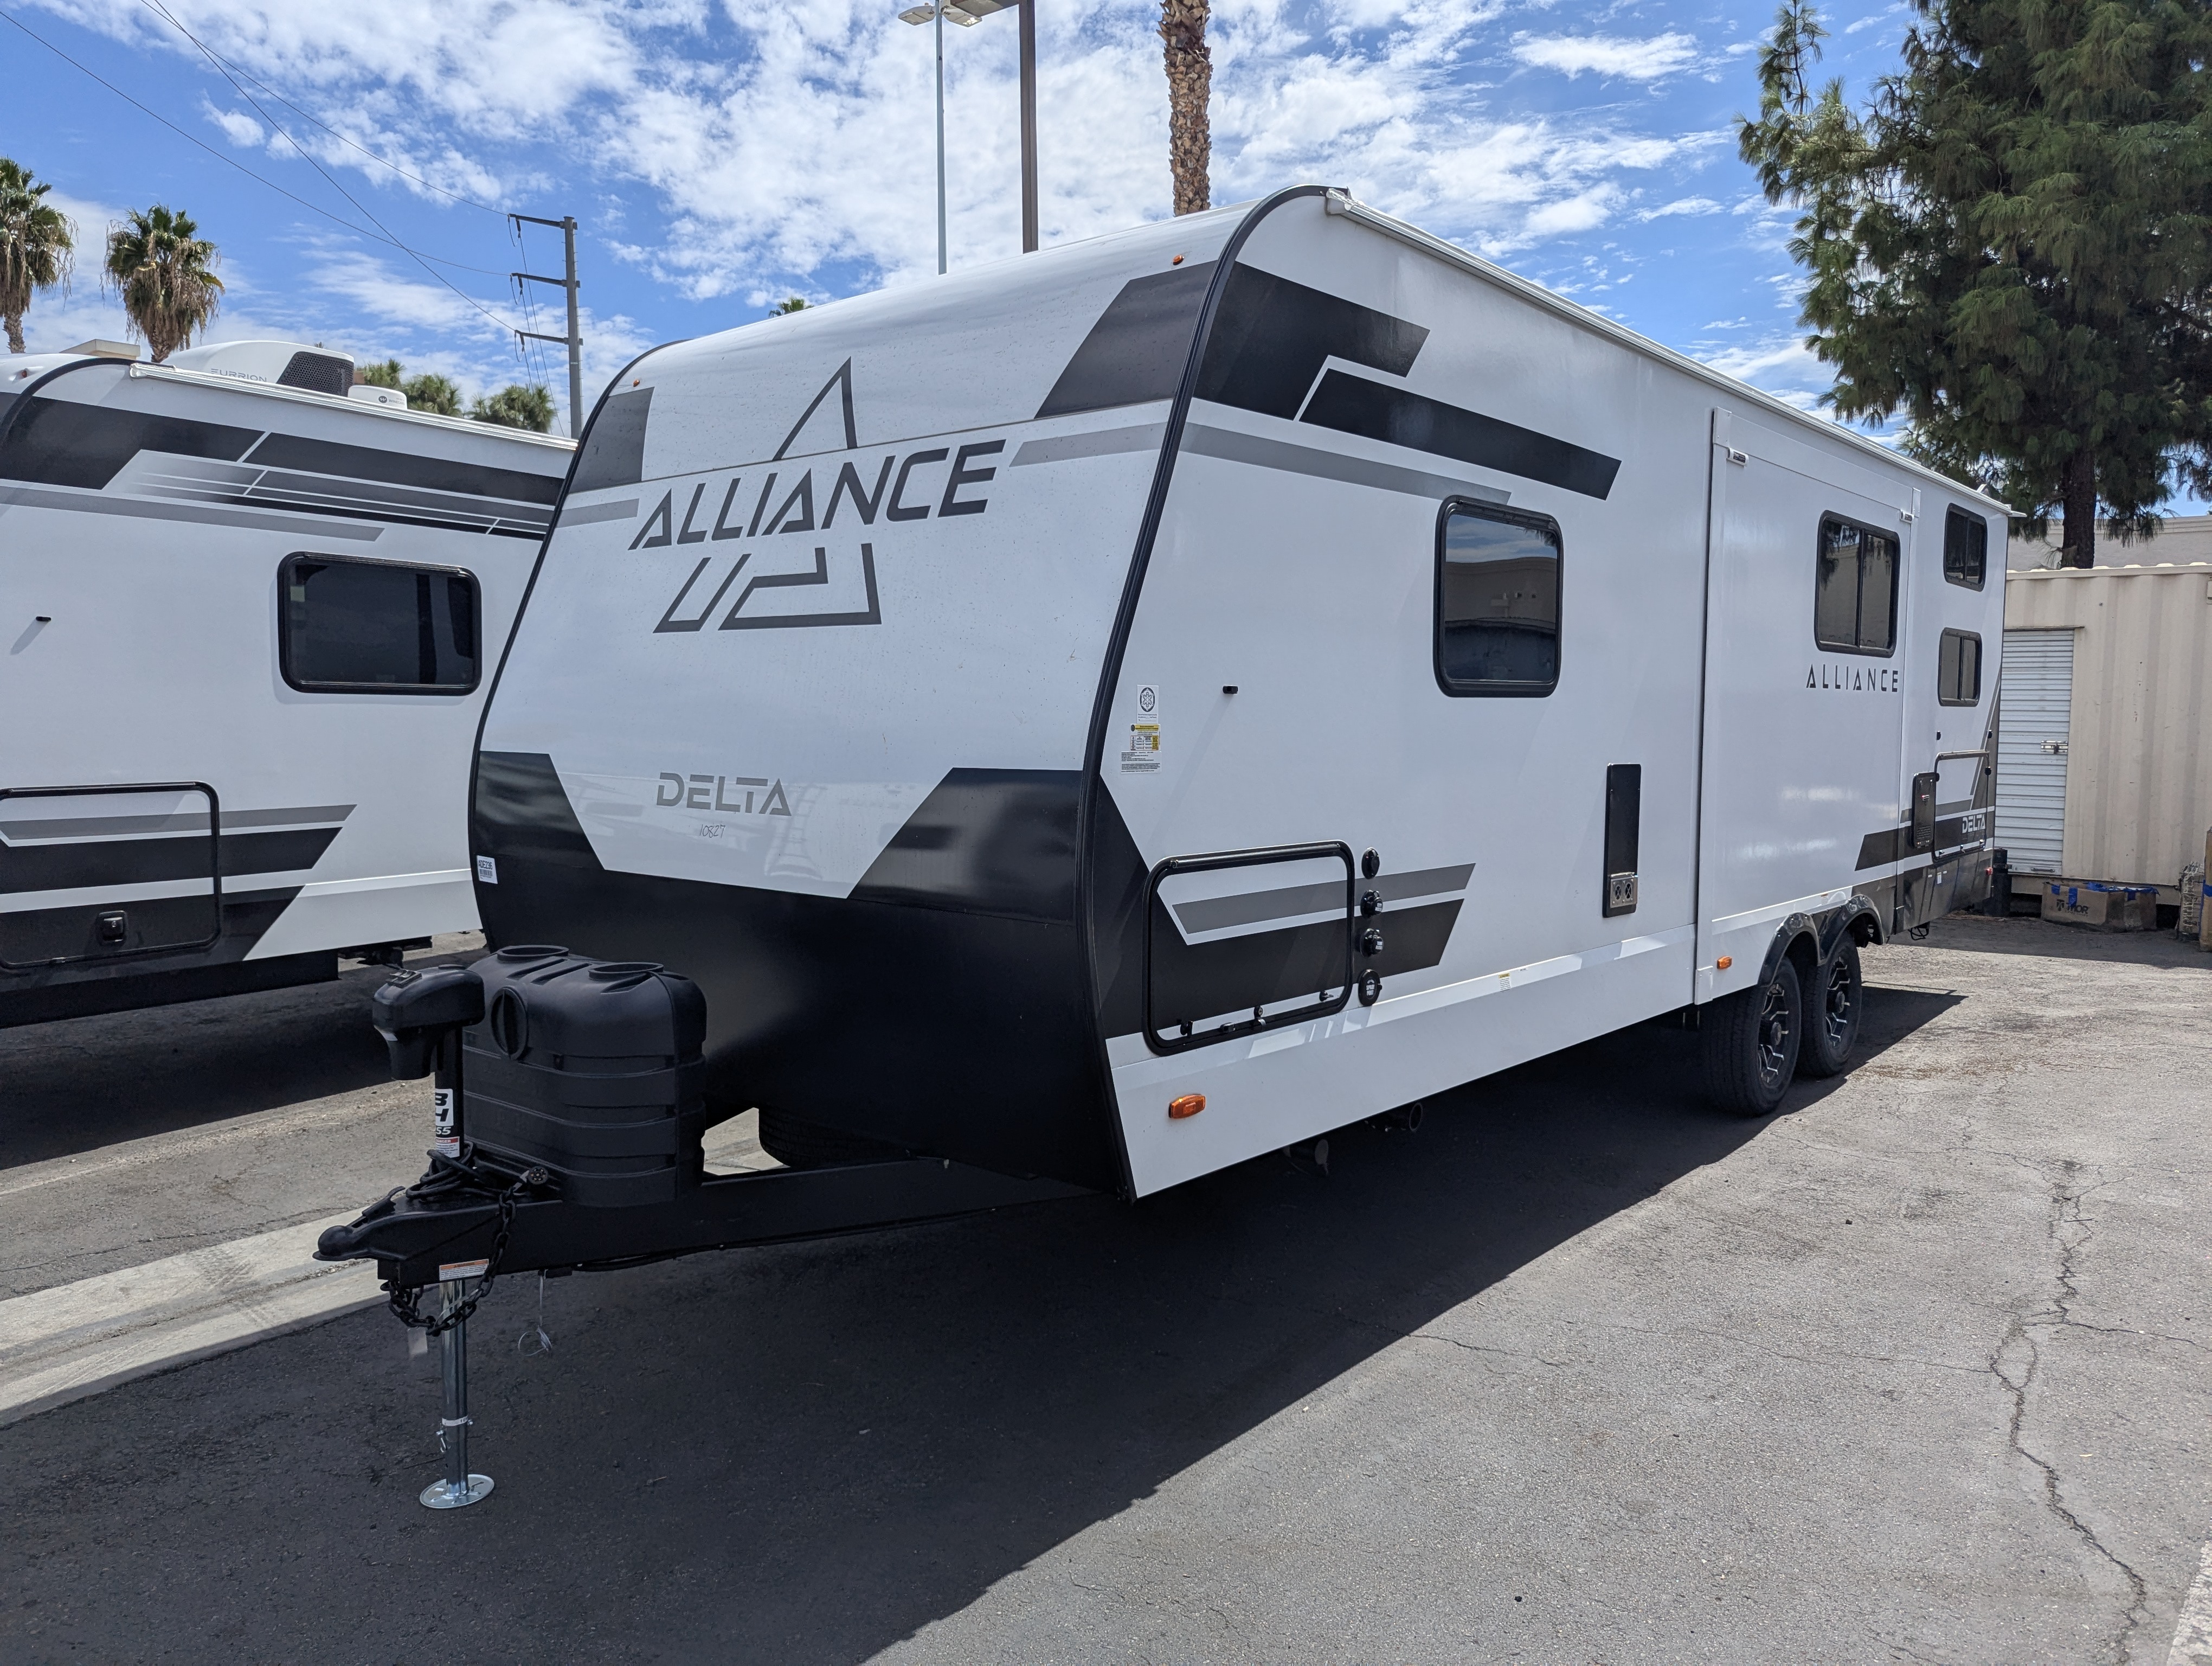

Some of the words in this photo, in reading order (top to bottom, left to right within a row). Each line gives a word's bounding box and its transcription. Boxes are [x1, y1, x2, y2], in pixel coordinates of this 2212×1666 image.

[211, 368, 267, 382] FURRION
[627, 439, 1007, 550] ALLIANCE
[1806, 664, 1898, 692] ALLIANCE
[657, 772, 792, 817] DELTA
[699, 824, 726, 838] 10827
[1962, 814, 1986, 834] DELTA
